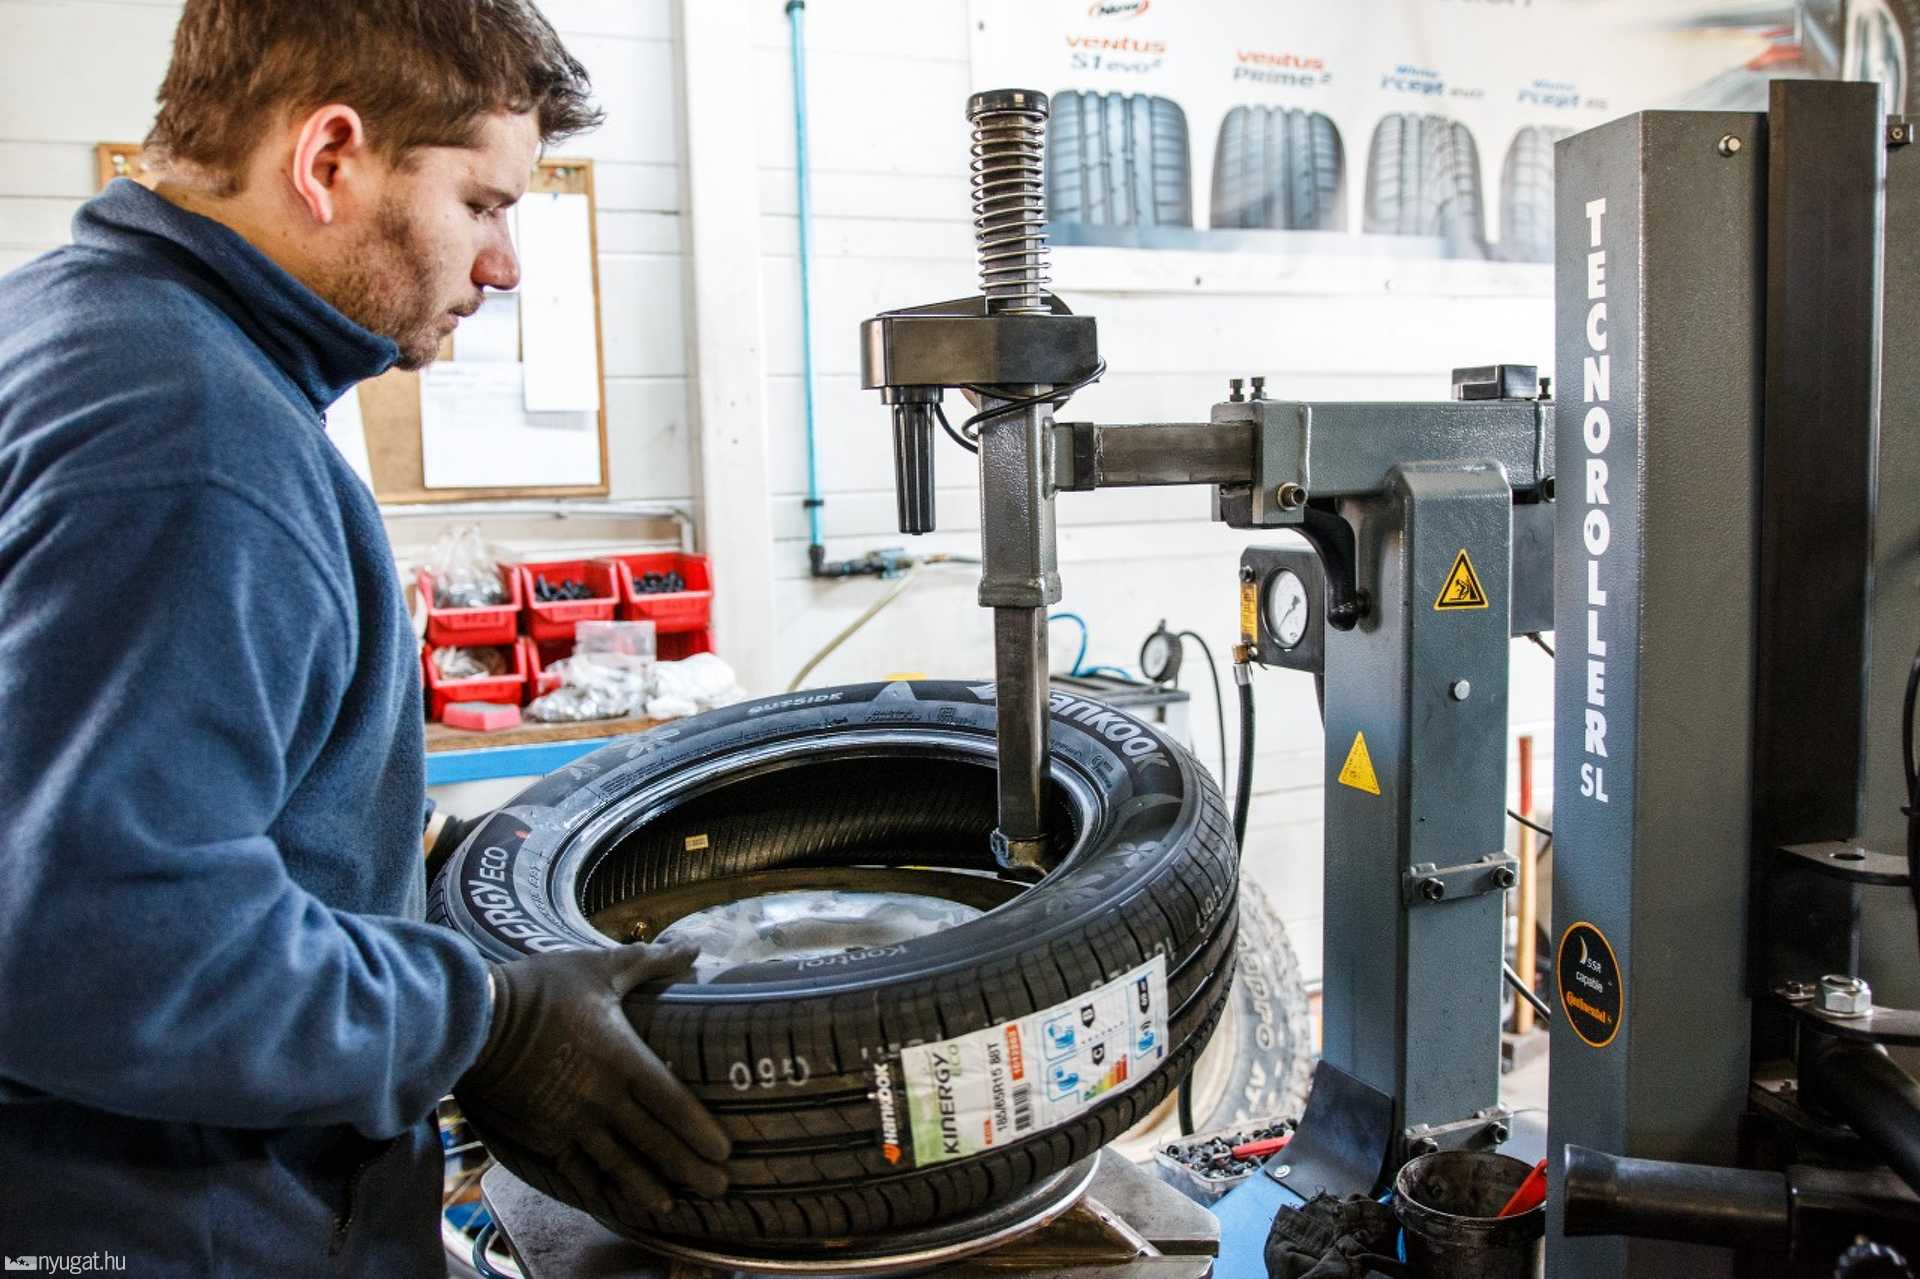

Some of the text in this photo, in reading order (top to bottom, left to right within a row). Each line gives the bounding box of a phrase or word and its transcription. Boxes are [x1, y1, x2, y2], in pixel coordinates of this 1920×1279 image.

[1580, 198, 1611, 803] TECNOROLLER SL
[479, 845, 506, 883] ECO
